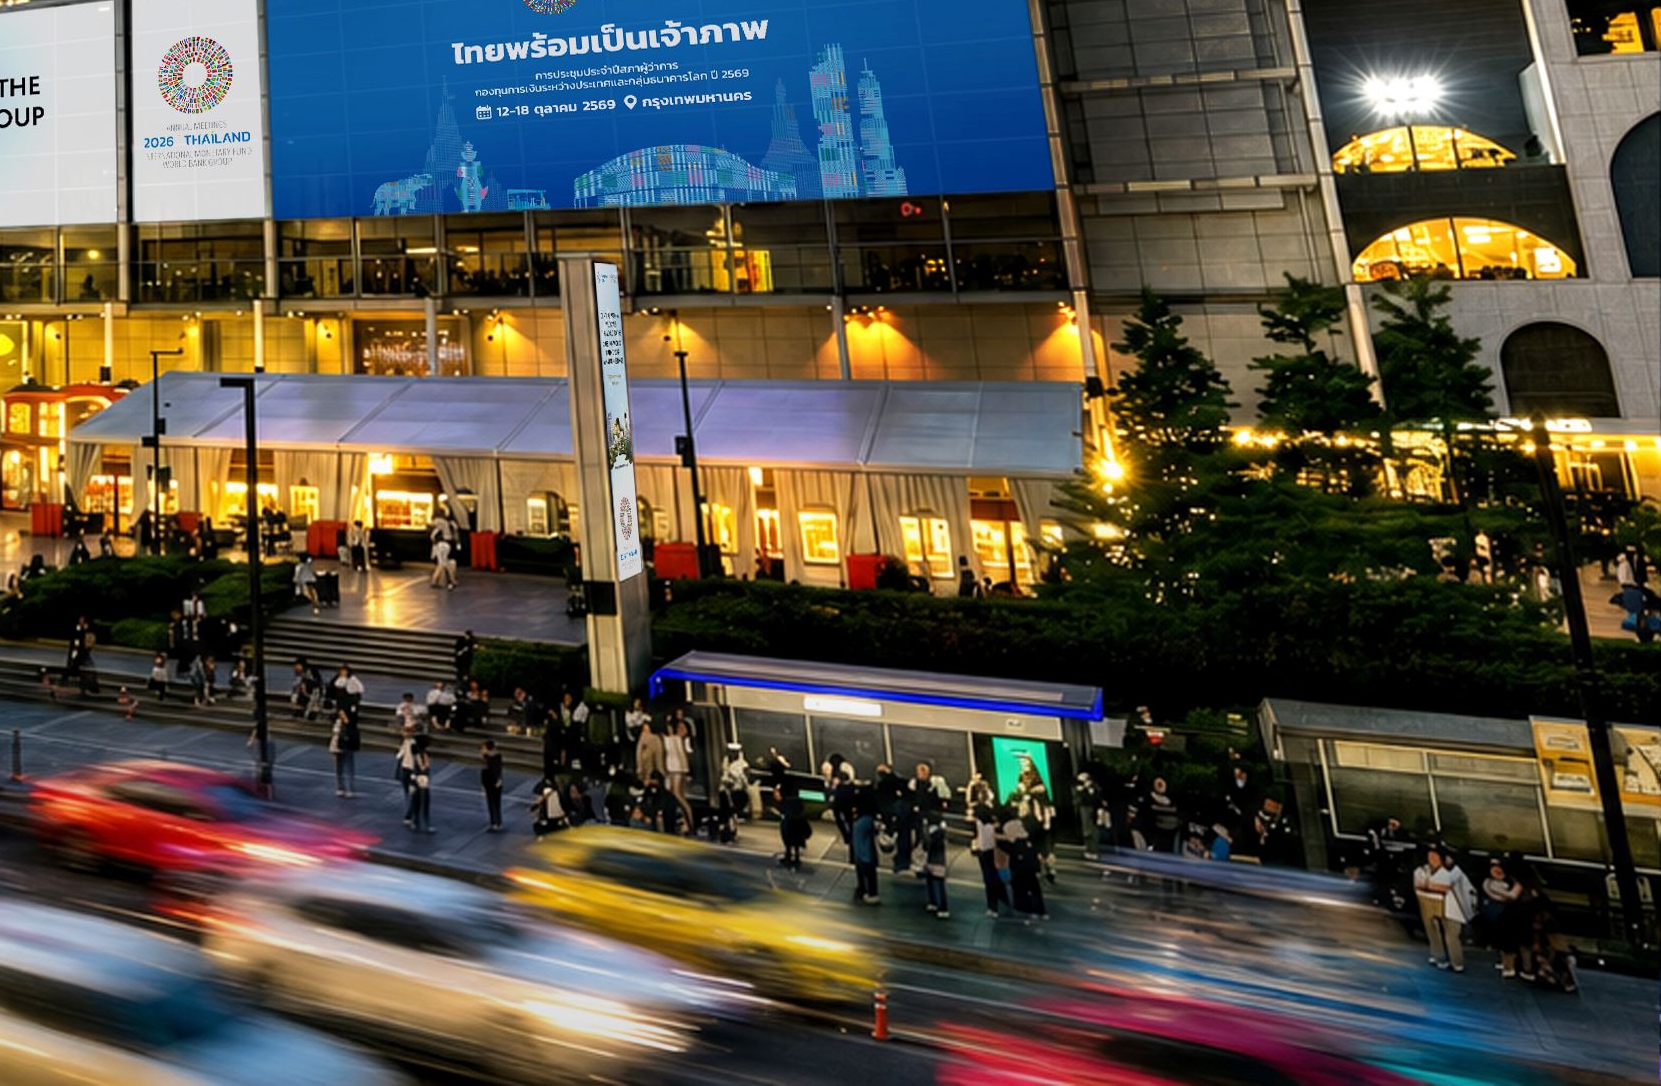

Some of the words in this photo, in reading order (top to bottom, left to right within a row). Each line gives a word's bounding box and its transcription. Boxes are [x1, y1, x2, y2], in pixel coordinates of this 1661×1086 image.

[451, 19, 769, 65] ไทยพร้อมเป็นเจ้าภาพ
[721, 68, 750, 80] 2569
[642, 89, 752, 109] กรุงเทพมหานคร
[496, 104, 529, 117] 12-18
[533, 102, 577, 120] ตุลาคม
[582, 99, 616, 112] 2569
[144, 137, 174, 149] 2026
